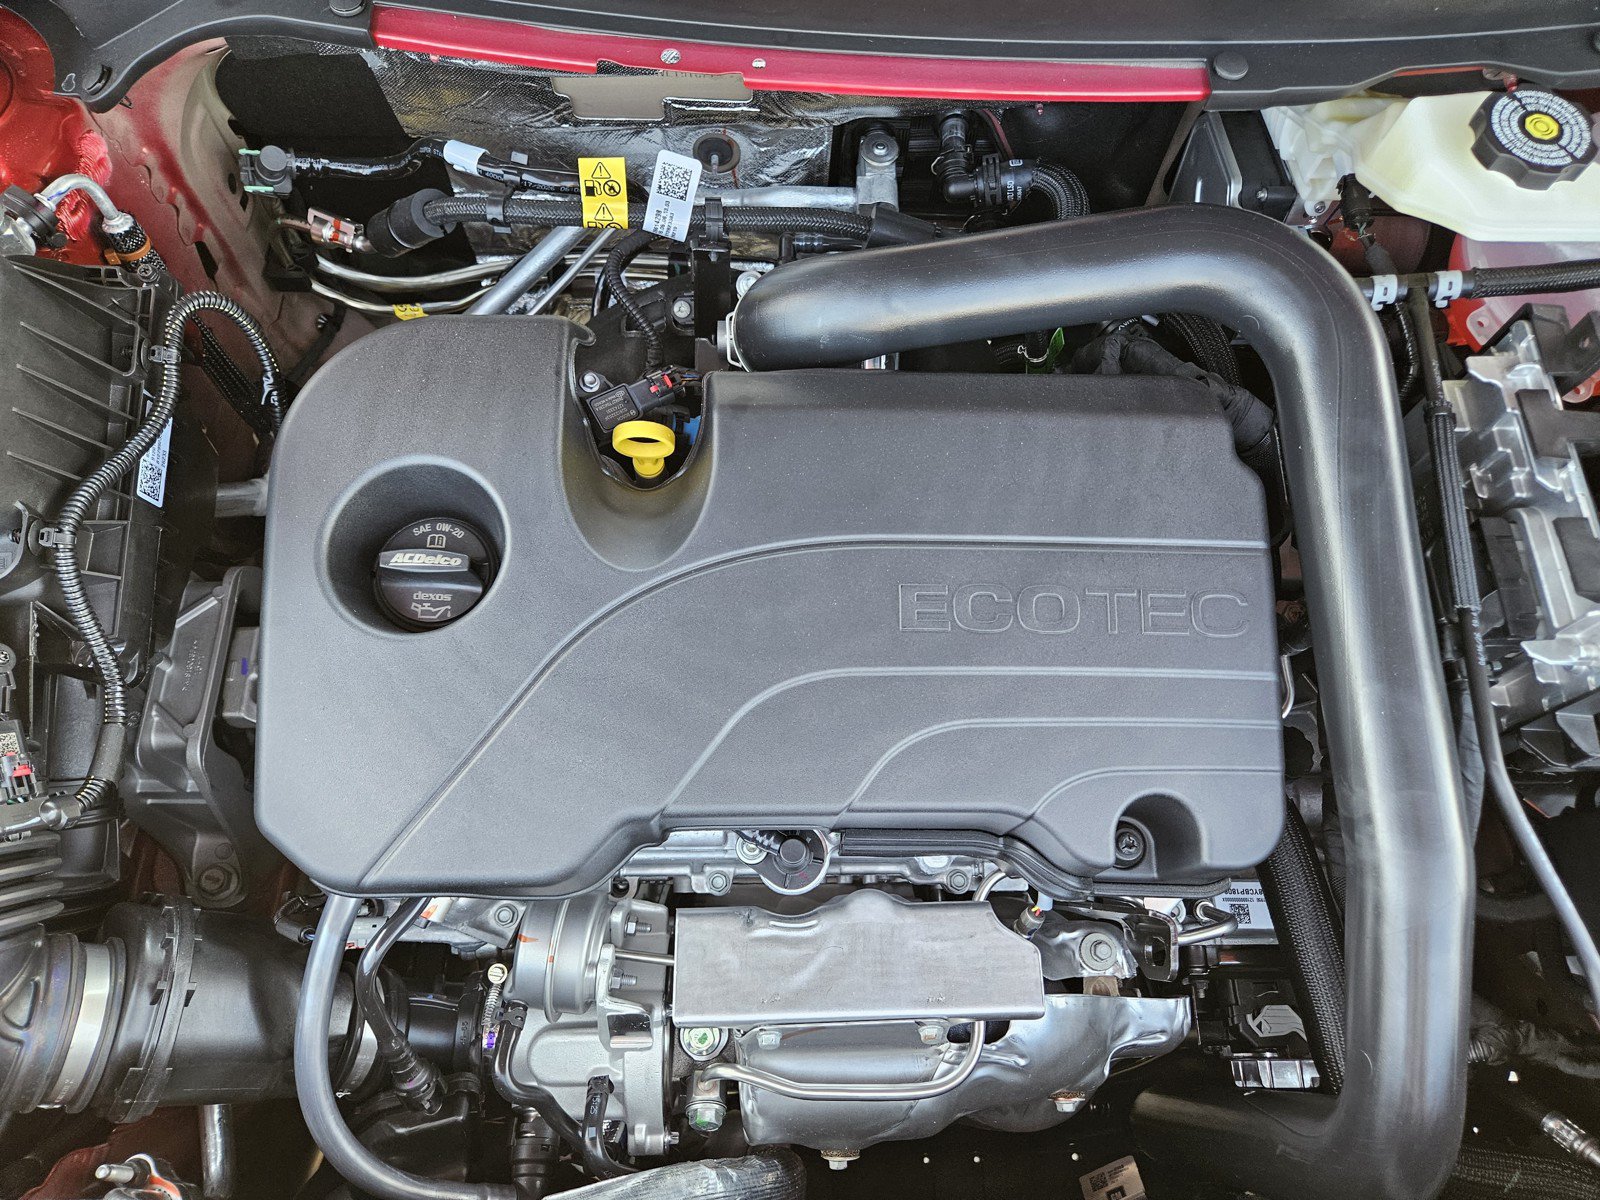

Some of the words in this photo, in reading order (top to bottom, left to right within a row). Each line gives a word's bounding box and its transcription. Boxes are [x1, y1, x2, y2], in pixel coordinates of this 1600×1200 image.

[413, 523, 432, 536] SAE
[436, 522, 465, 539] 0W-20
[390, 553, 462, 566] ACDelco
[413, 591, 453, 602] dexos
[899, 583, 1249, 637] ECOTEC
